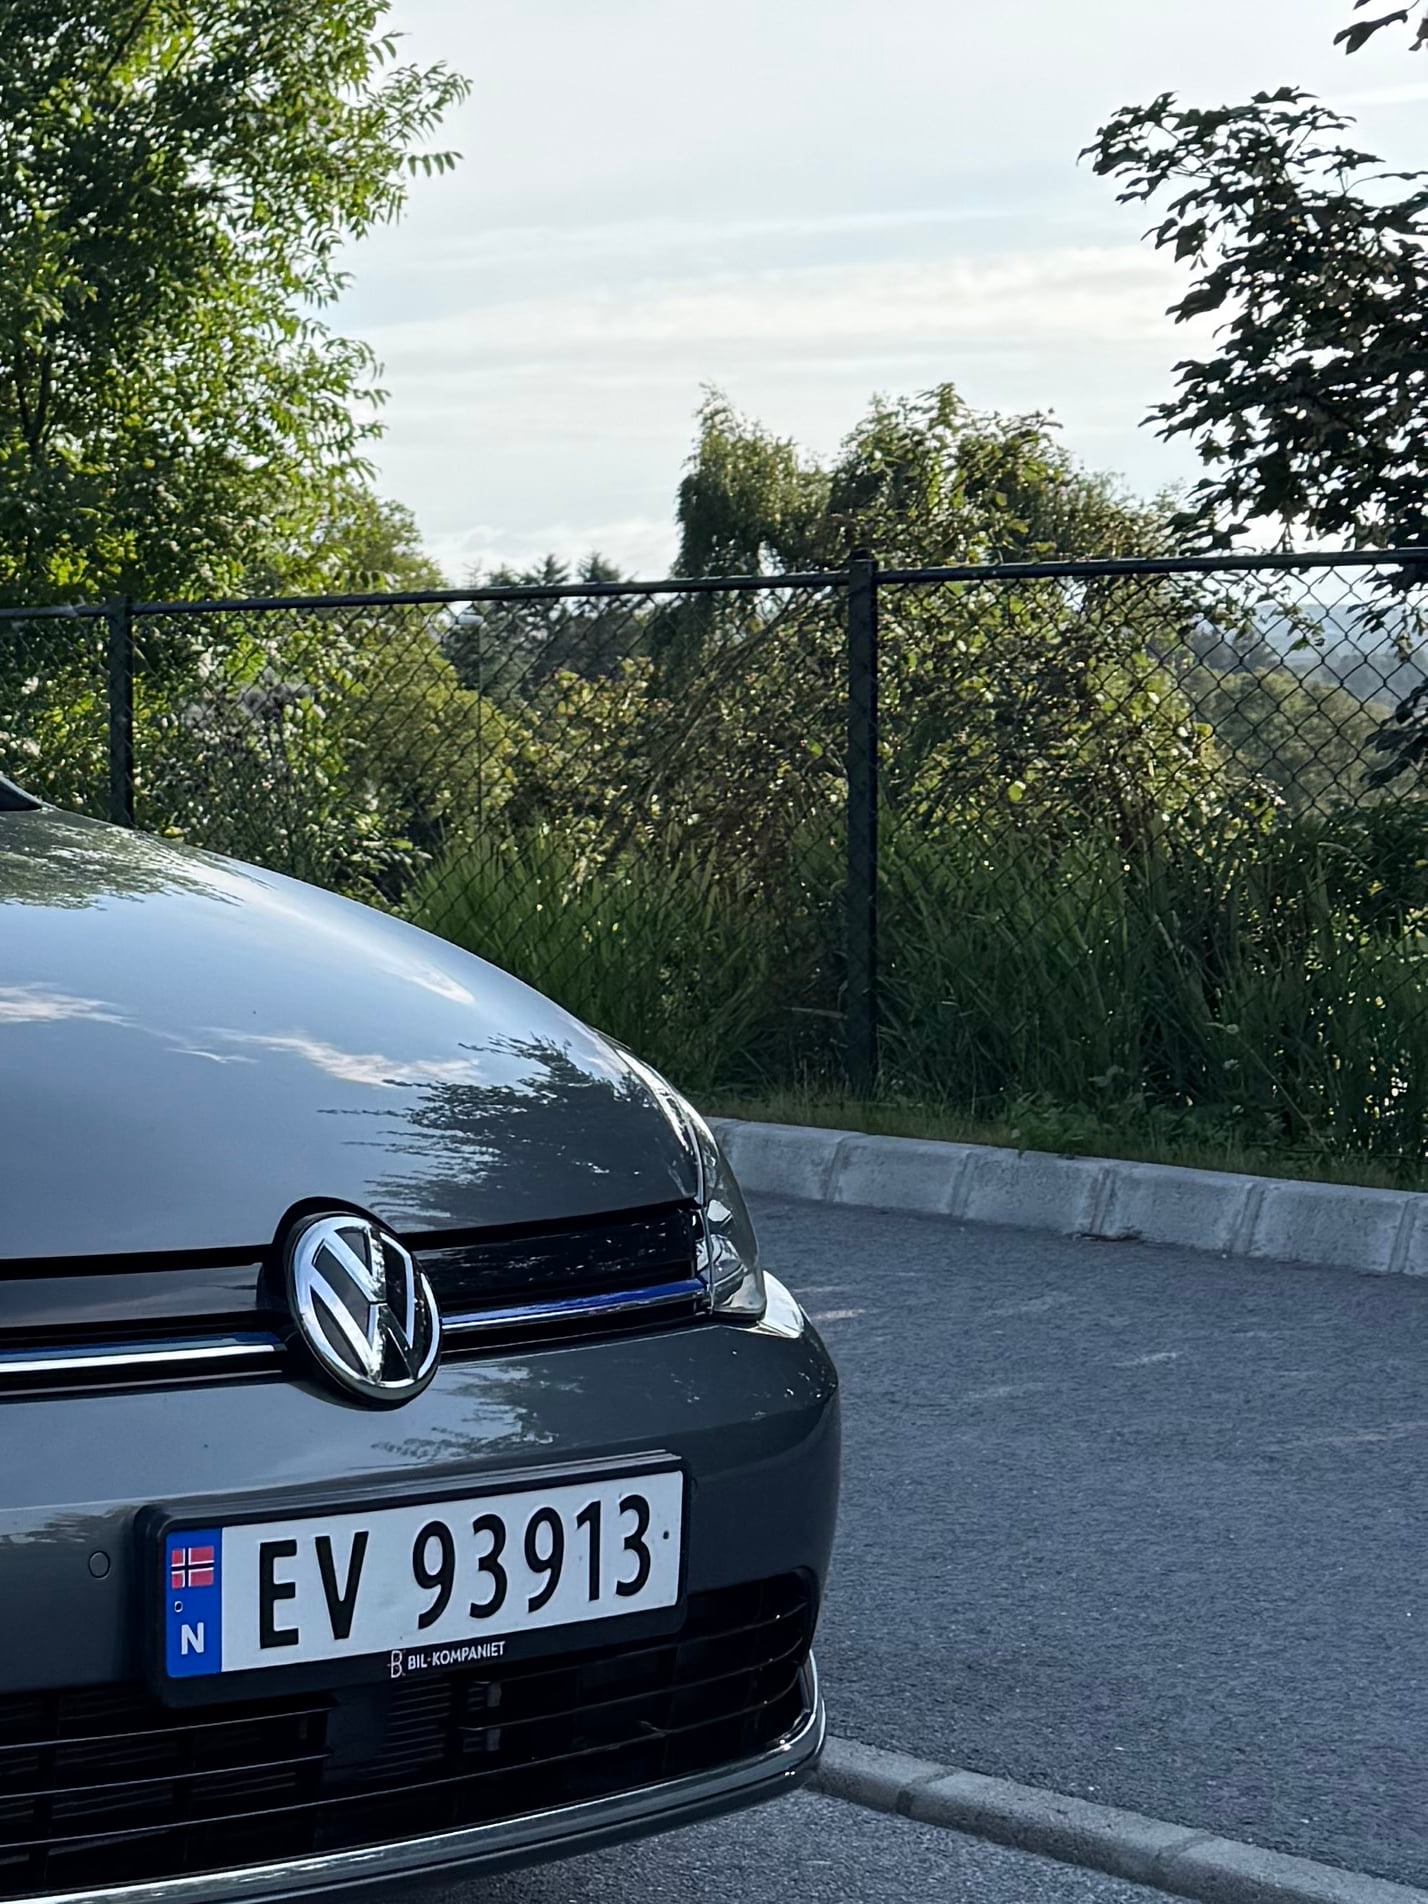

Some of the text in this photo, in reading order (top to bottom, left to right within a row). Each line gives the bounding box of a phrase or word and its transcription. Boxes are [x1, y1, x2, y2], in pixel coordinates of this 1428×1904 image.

[258, 1494, 651, 1649] EV 93913
[181, 1623, 205, 1655] N
